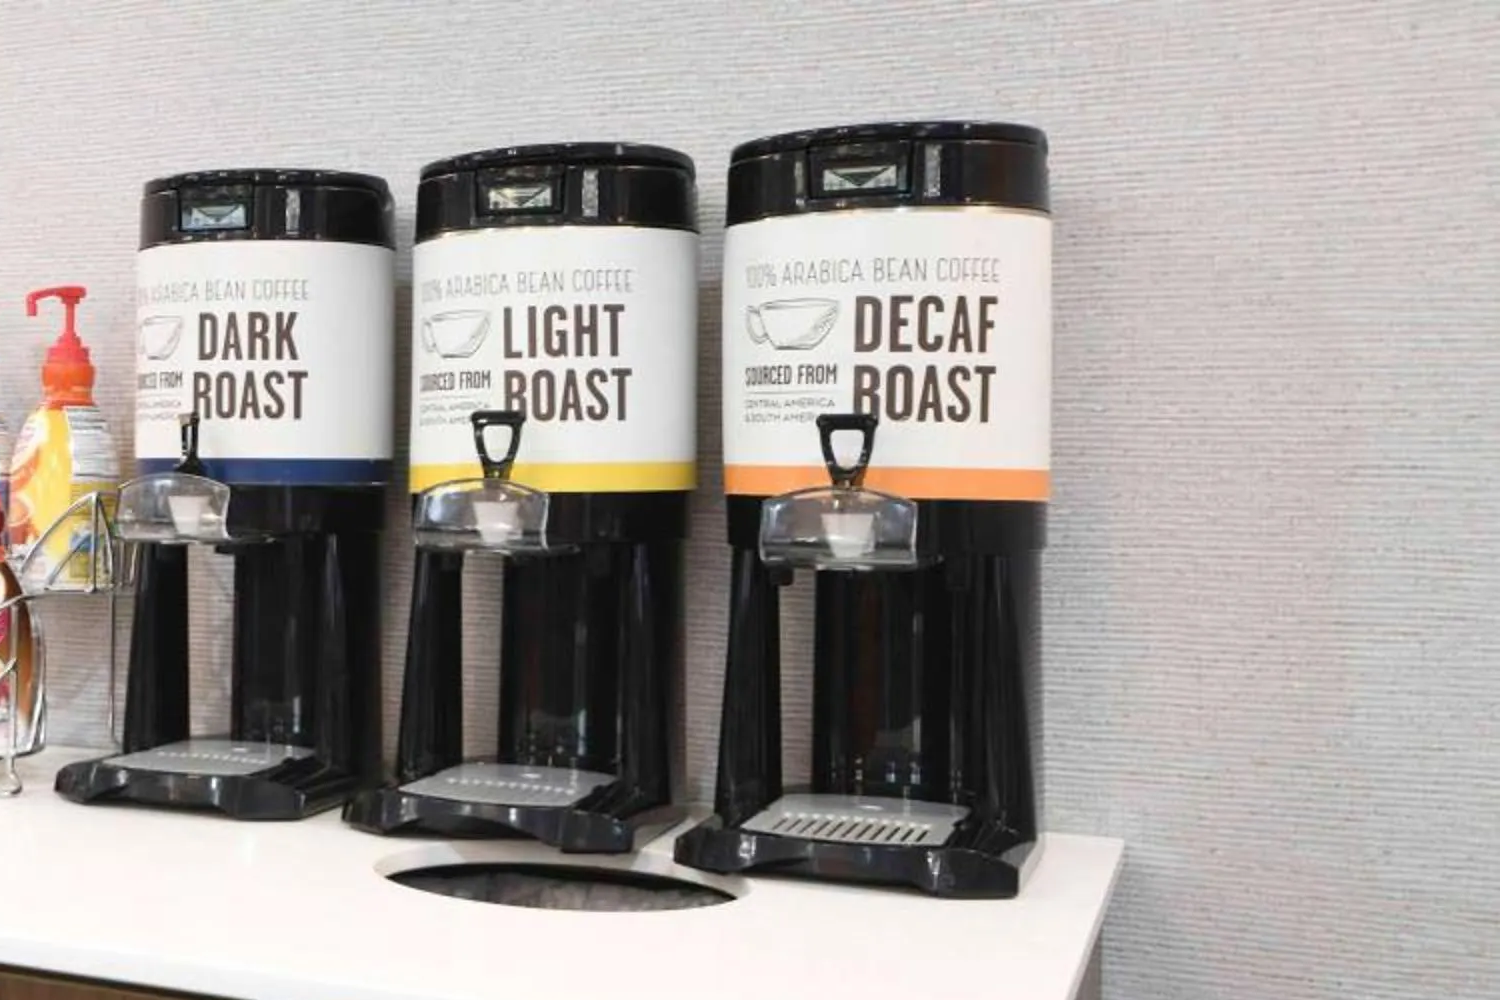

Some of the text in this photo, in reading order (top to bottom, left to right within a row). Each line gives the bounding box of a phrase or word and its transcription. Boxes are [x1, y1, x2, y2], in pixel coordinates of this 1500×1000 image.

[445, 273, 509, 298] ARABICA
[517, 271, 564, 293] BEAN
[572, 269, 633, 293] COFFEE
[782, 260, 864, 286] ARABICA
[873, 258, 927, 283] BEAN
[937, 257, 1000, 283] COFFEE
[205, 279, 246, 301] BEAN
[252, 279, 309, 301] COFFEE
[198, 311, 299, 361] DARK
[503, 304, 625, 359] LIGHT
[854, 295, 999, 353] DECAF
[159, 371, 183, 389] FROM
[459, 369, 491, 390] FROM
[745, 363, 838, 387] SOURCED FROM
[193, 370, 309, 420] ROAST
[503, 368, 633, 422] ROAST
[784, 396, 836, 409] AMERICA
[853, 364, 997, 423] ROAST
